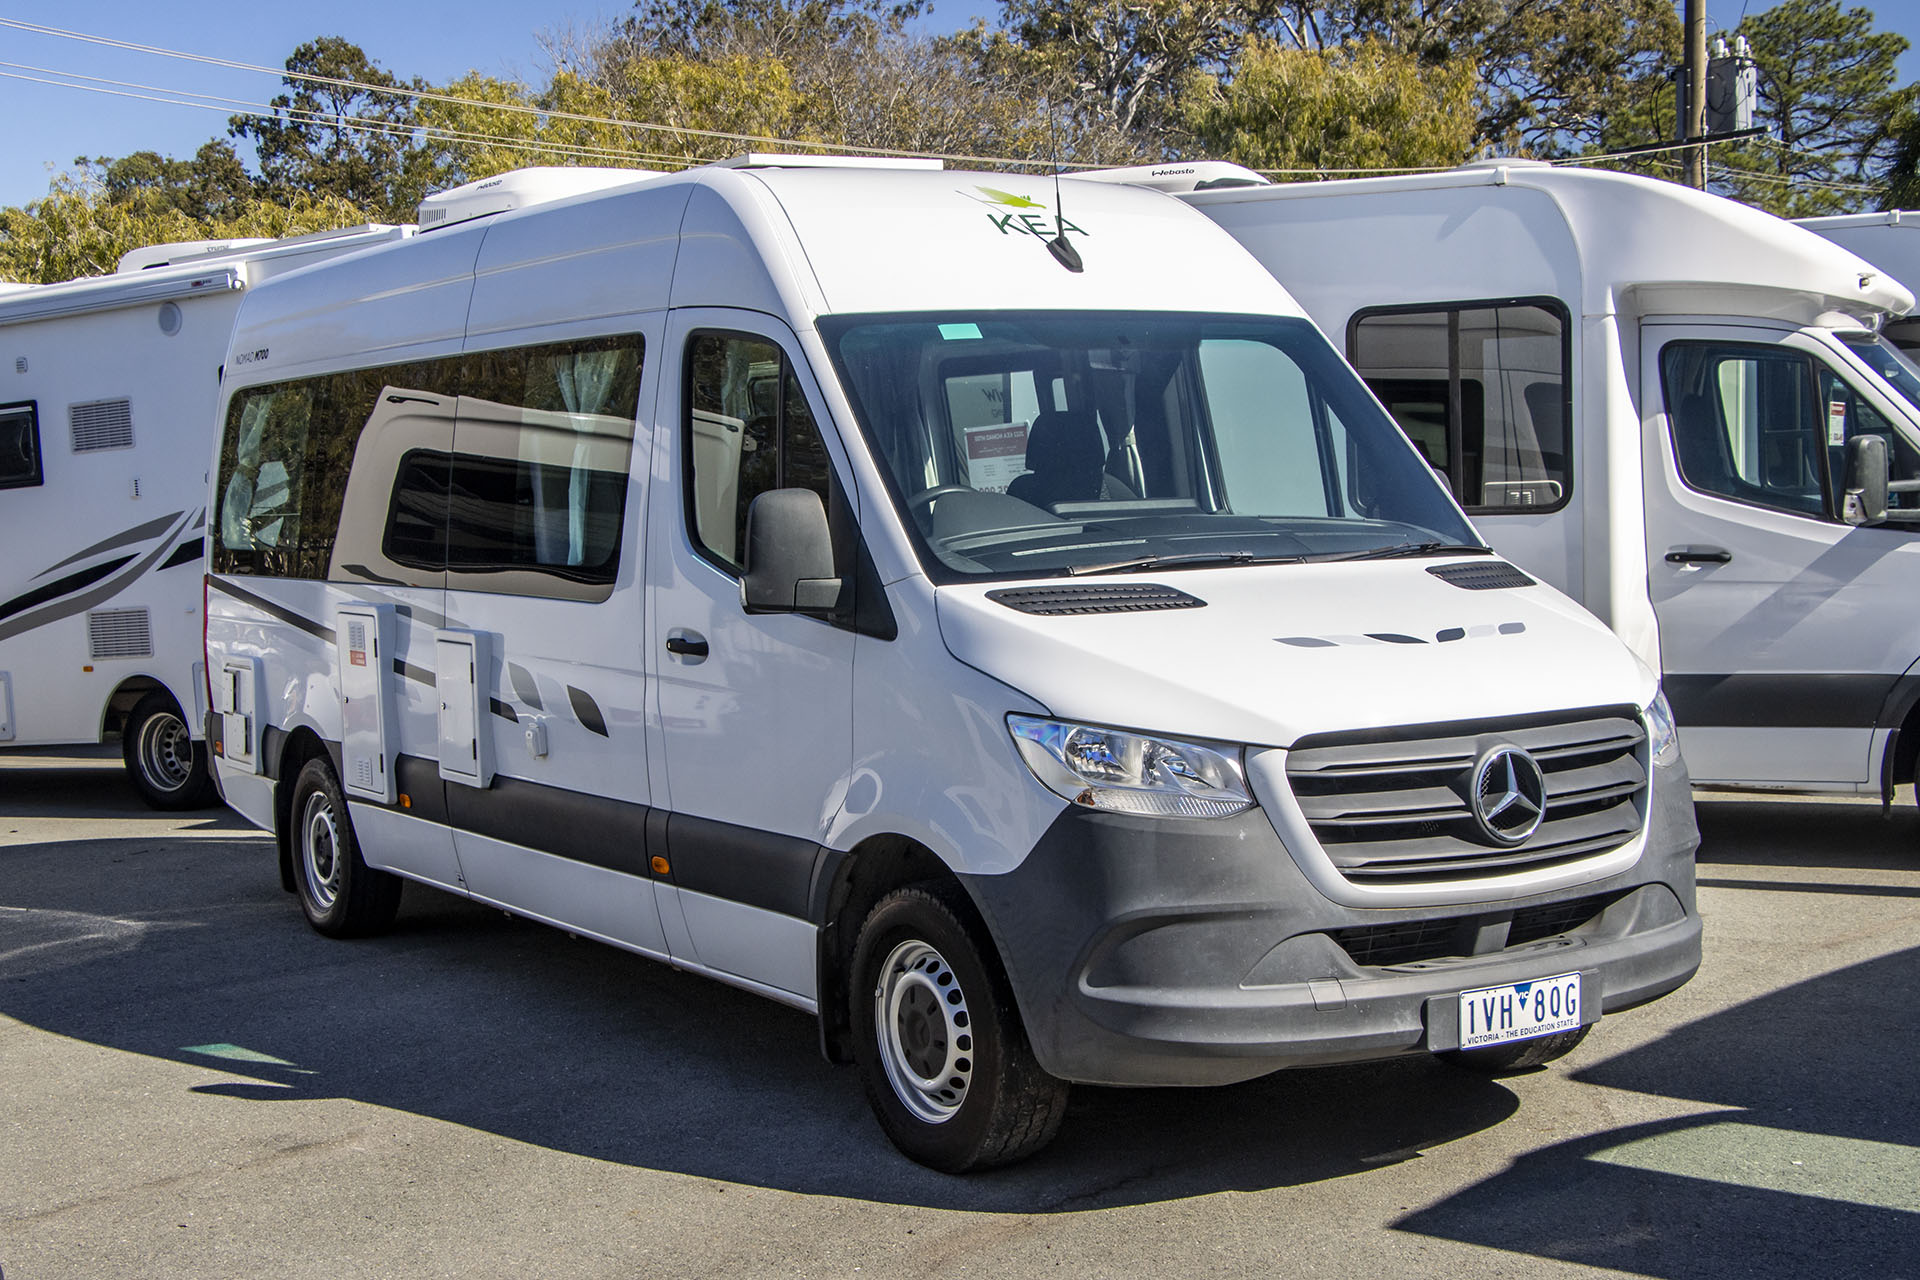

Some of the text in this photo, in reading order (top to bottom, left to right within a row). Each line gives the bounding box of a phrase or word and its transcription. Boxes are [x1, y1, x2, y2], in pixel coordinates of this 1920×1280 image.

[1151, 168, 1195, 177] Webasto
[986, 213, 1090, 236] KEA
[1517, 990, 1530, 1000] VIC
[1468, 983, 1577, 1035] 1VH 8QG
[1467, 1034, 1500, 1045] VICTORIA
[1506, 1030, 1519, 1038] THE
[1520, 1023, 1556, 1036] EDUCATION
[1556, 1018, 1575, 1030] STATE
